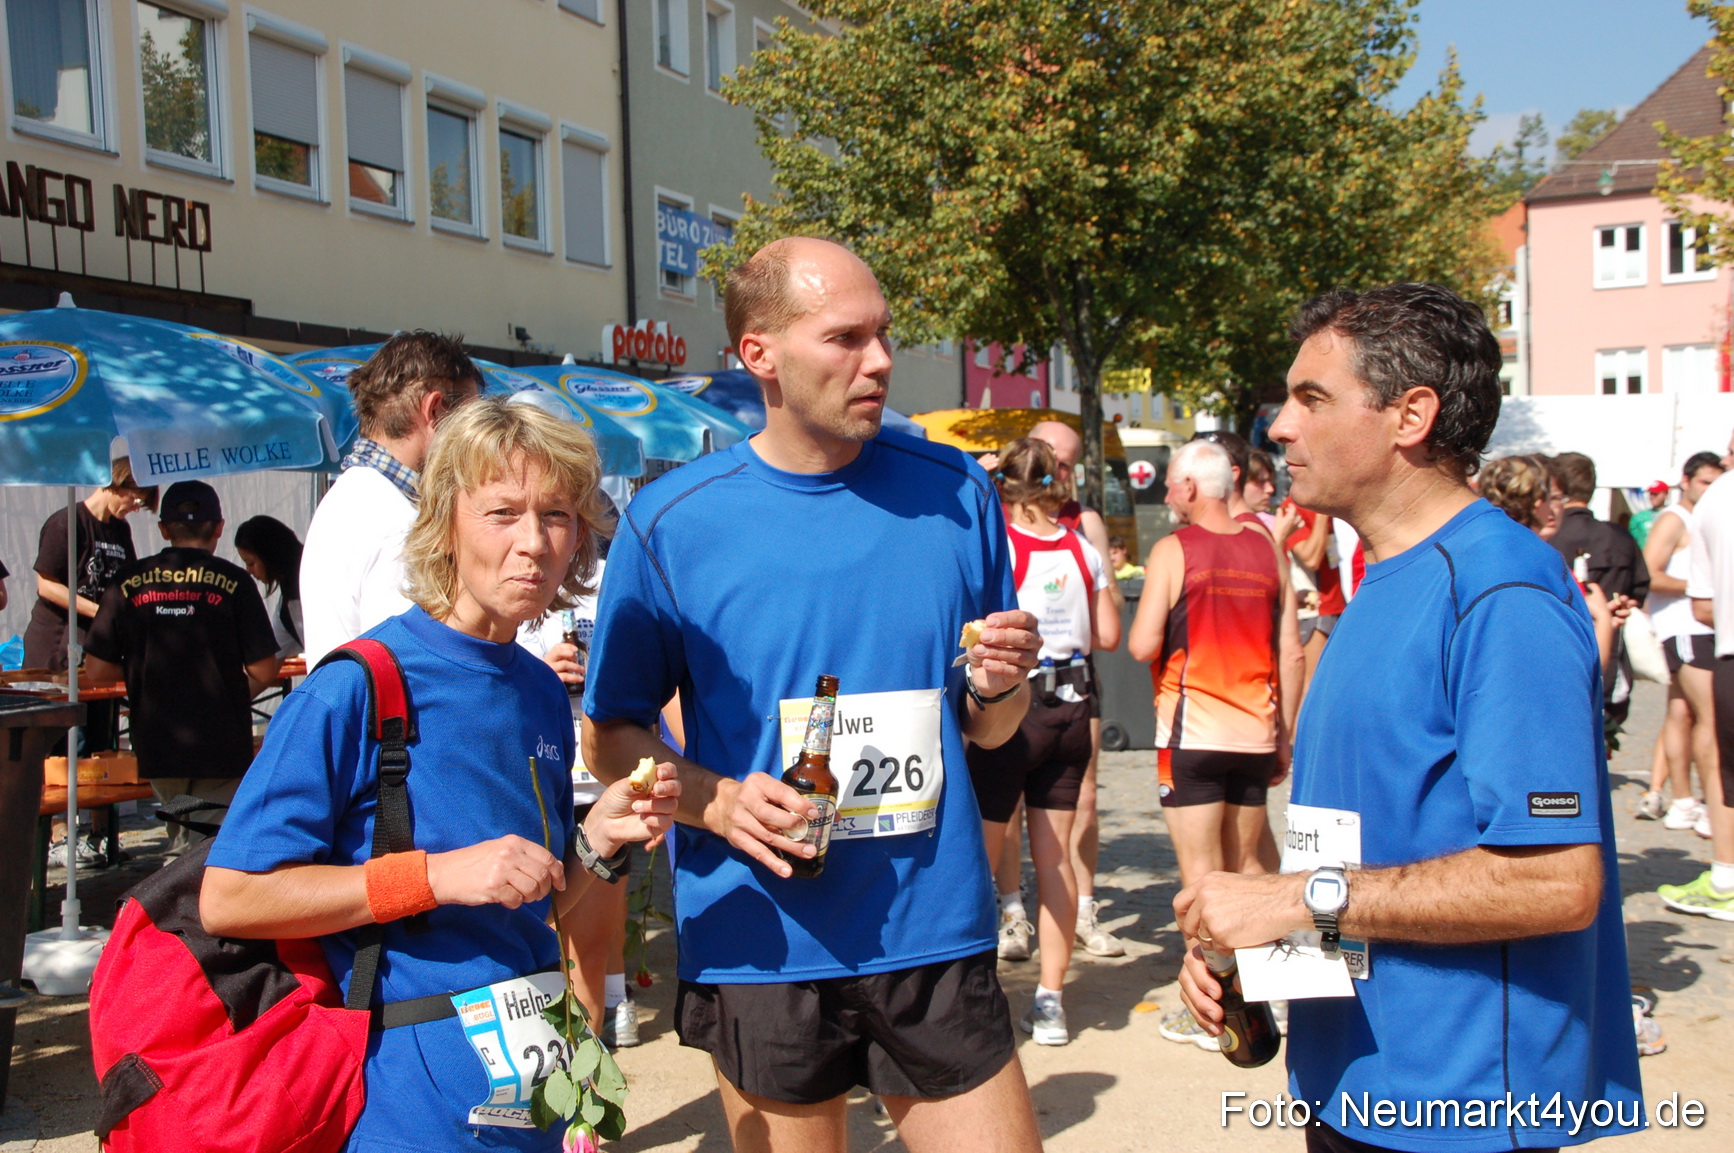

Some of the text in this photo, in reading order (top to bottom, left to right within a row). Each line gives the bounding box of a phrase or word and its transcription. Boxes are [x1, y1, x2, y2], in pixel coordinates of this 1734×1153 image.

[113, 184, 212, 252] NERO
[658, 208, 700, 244] BÜRO
[660, 241, 688, 269] TEL
[612, 318, 687, 366] profoto
[147, 442, 292, 475] HELLE WOLKE
[131, 590, 202, 607] Weltmeister
[156, 606, 187, 616] Kempa
[852, 754, 924, 797] 226
[1286, 820, 1319, 853] obert
